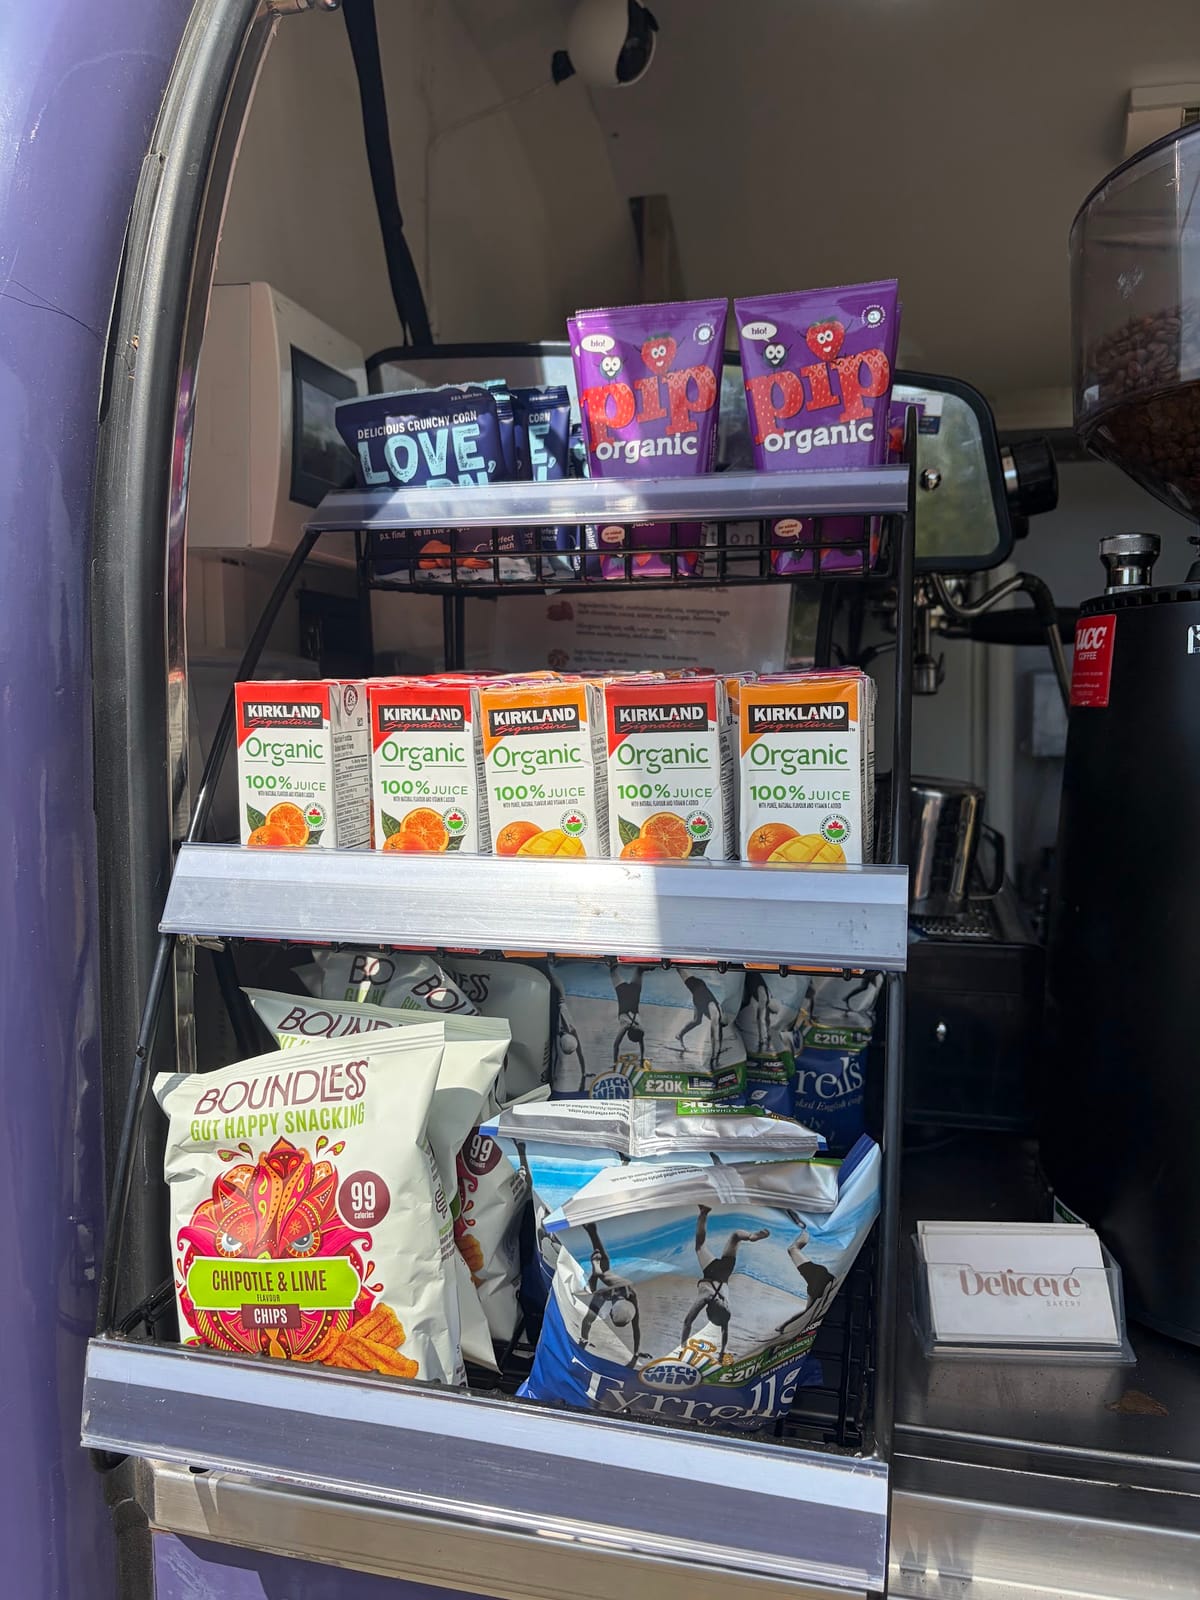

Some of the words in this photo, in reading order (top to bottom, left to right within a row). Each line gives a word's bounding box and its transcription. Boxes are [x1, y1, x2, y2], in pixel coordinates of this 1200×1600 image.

[746, 349, 890, 446] pip
[582, 364, 717, 451] pip
[357, 421, 406, 440] DELICIOUS
[407, 415, 450, 433] CRUNCHY
[453, 410, 477, 425] CORN
[529, 412, 551, 423] CORN
[764, 420, 874, 453] organic
[596, 432, 698, 463] organic
[1076, 626, 1107, 651] UCC
[1078, 651, 1097, 660] COFFEE
[247, 704, 321, 719] KIRKLAND
[383, 708, 462, 722] KIRKLAND
[493, 707, 576, 725] KIRKLAND
[619, 706, 704, 723] KIRKLAND
[754, 705, 845, 722] KIRKLAND
[248, 718, 320, 728] Signature
[383, 721, 462, 731] Signature
[495, 722, 577, 736] Signature
[620, 721, 704, 733] Signature
[754, 721, 845, 733] Signature
[246, 736, 323, 766] Organic
[381, 739, 465, 771] Organic
[493, 743, 581, 775] Organic
[617, 743, 708, 774] Organic
[750, 743, 848, 776] Organic
[245, 775, 292, 790] 100%
[294, 781, 326, 791] JUICE
[381, 780, 430, 795] 100%
[431, 785, 469, 795] JUICE
[494, 784, 545, 800] 100%
[547, 786, 586, 798] JUICE
[617, 784, 670, 800] 100%
[672, 788, 712, 798] JUICE
[750, 785, 805, 800] 100%
[808, 790, 851, 801] JUICE
[194, 1061, 368, 1115] BOUNDLESS
[593, 1077, 629, 1092] CATCH
[645, 1079, 682, 1094] £20K
[190, 1116, 220, 1142] GUT
[225, 1112, 279, 1139] HAPPY
[284, 1103, 366, 1134] SNACKING
[470, 1134, 493, 1162] 99
[351, 1182, 375, 1210] 99
[354, 1212, 375, 1220] calories
[212, 1270, 274, 1293] CHIPOTLE
[278, 1271, 288, 1292] &
[291, 1269, 327, 1292] LIME
[256, 1294, 280, 1302] FLAVOUR
[1046, 1300, 1081, 1308] BAKERY
[253, 1308, 288, 1324] CHIPS
[645, 1365, 697, 1377] CATCH
